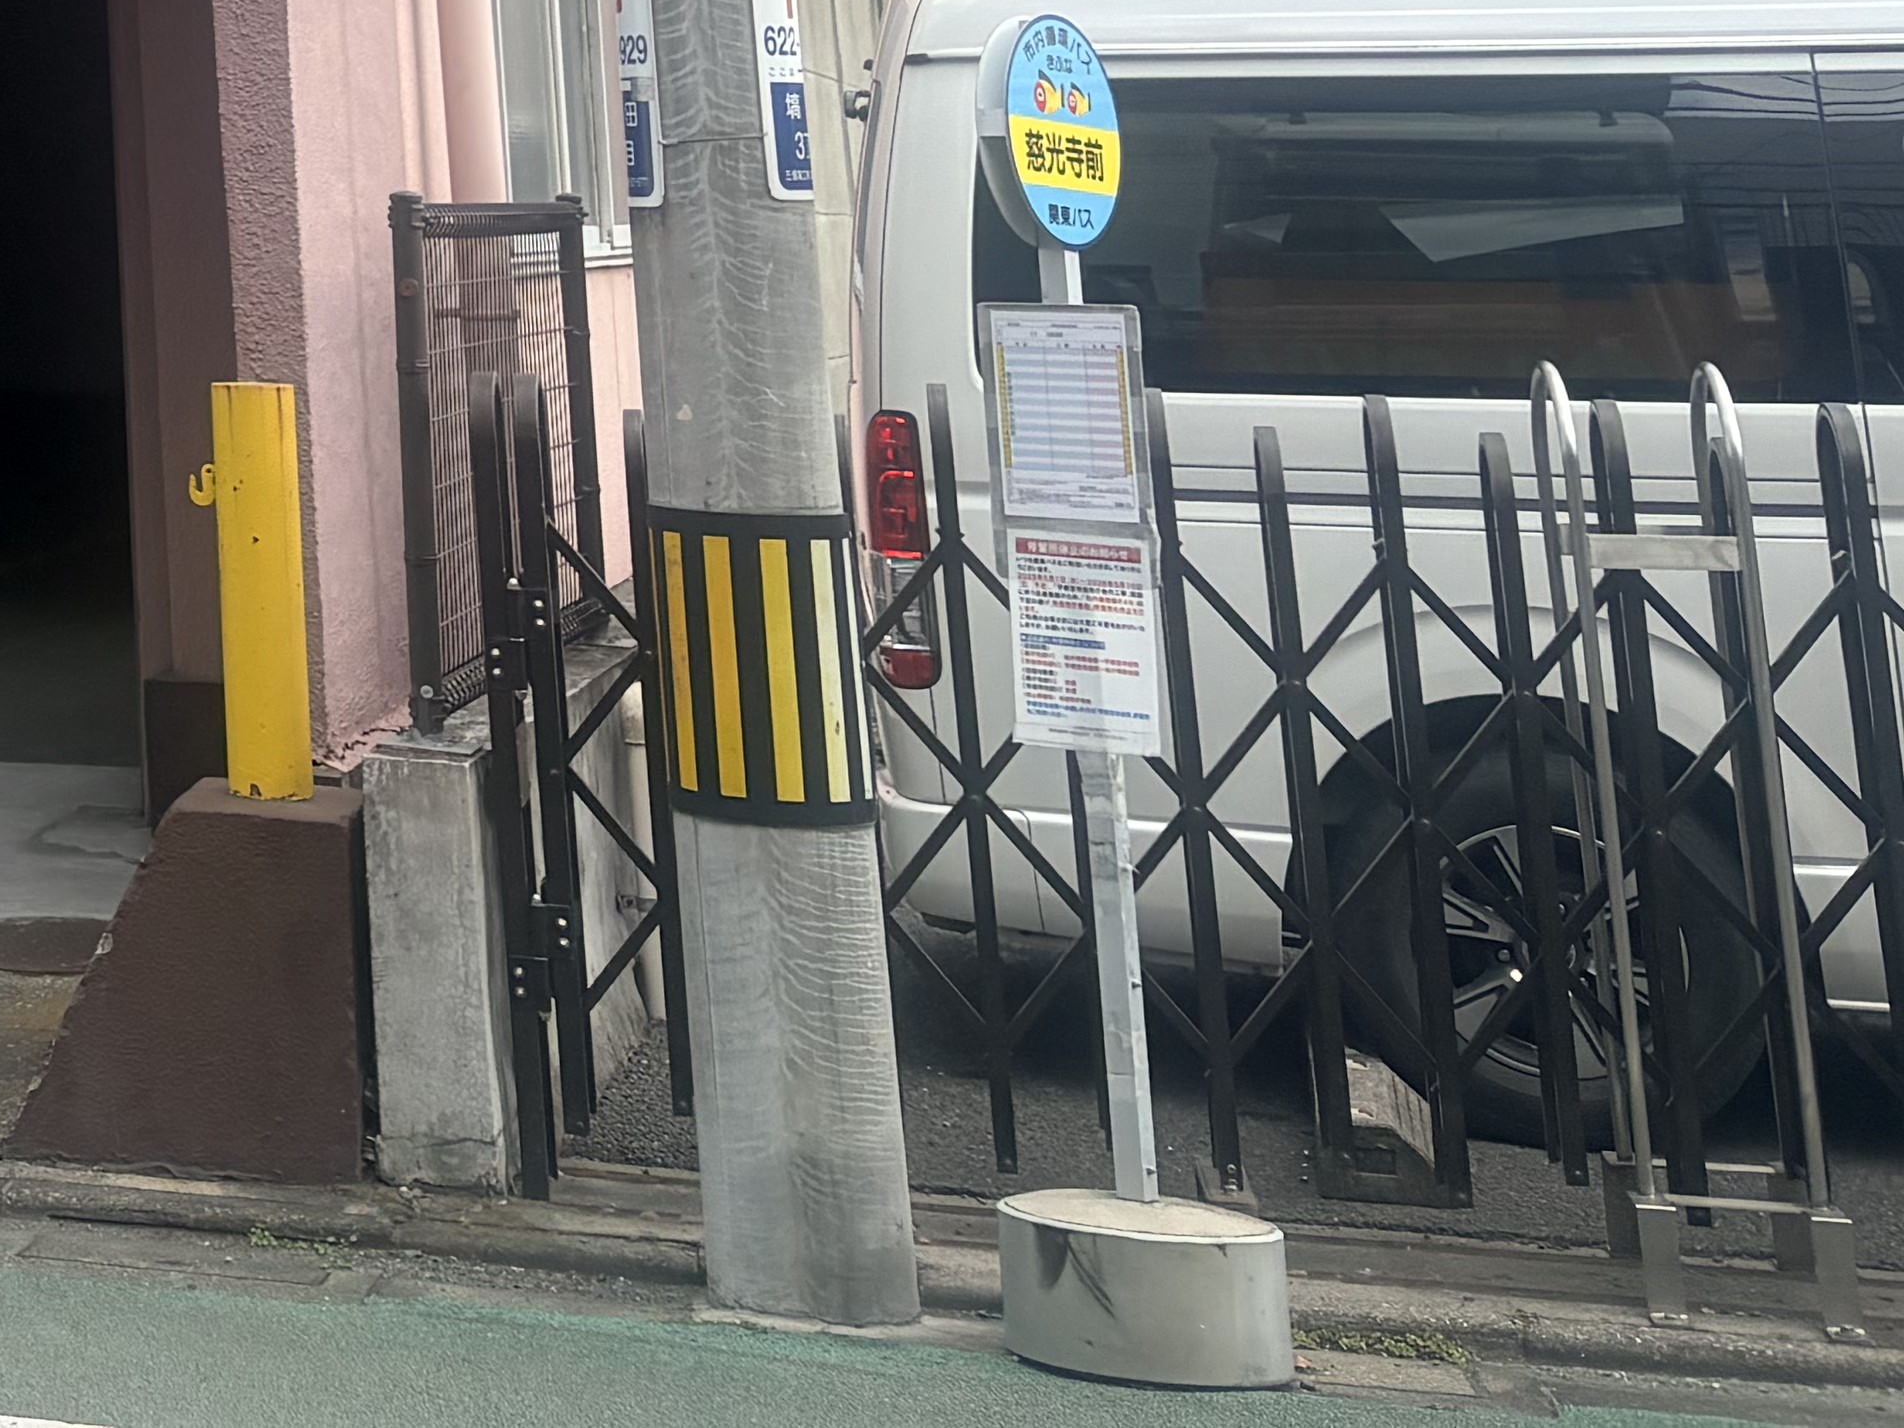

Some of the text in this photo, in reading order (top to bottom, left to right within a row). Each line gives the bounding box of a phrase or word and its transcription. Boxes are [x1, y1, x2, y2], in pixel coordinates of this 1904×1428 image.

[1024, 128, 1105, 183] 慈光寺前
[1047, 203, 1095, 230] 関東バス
